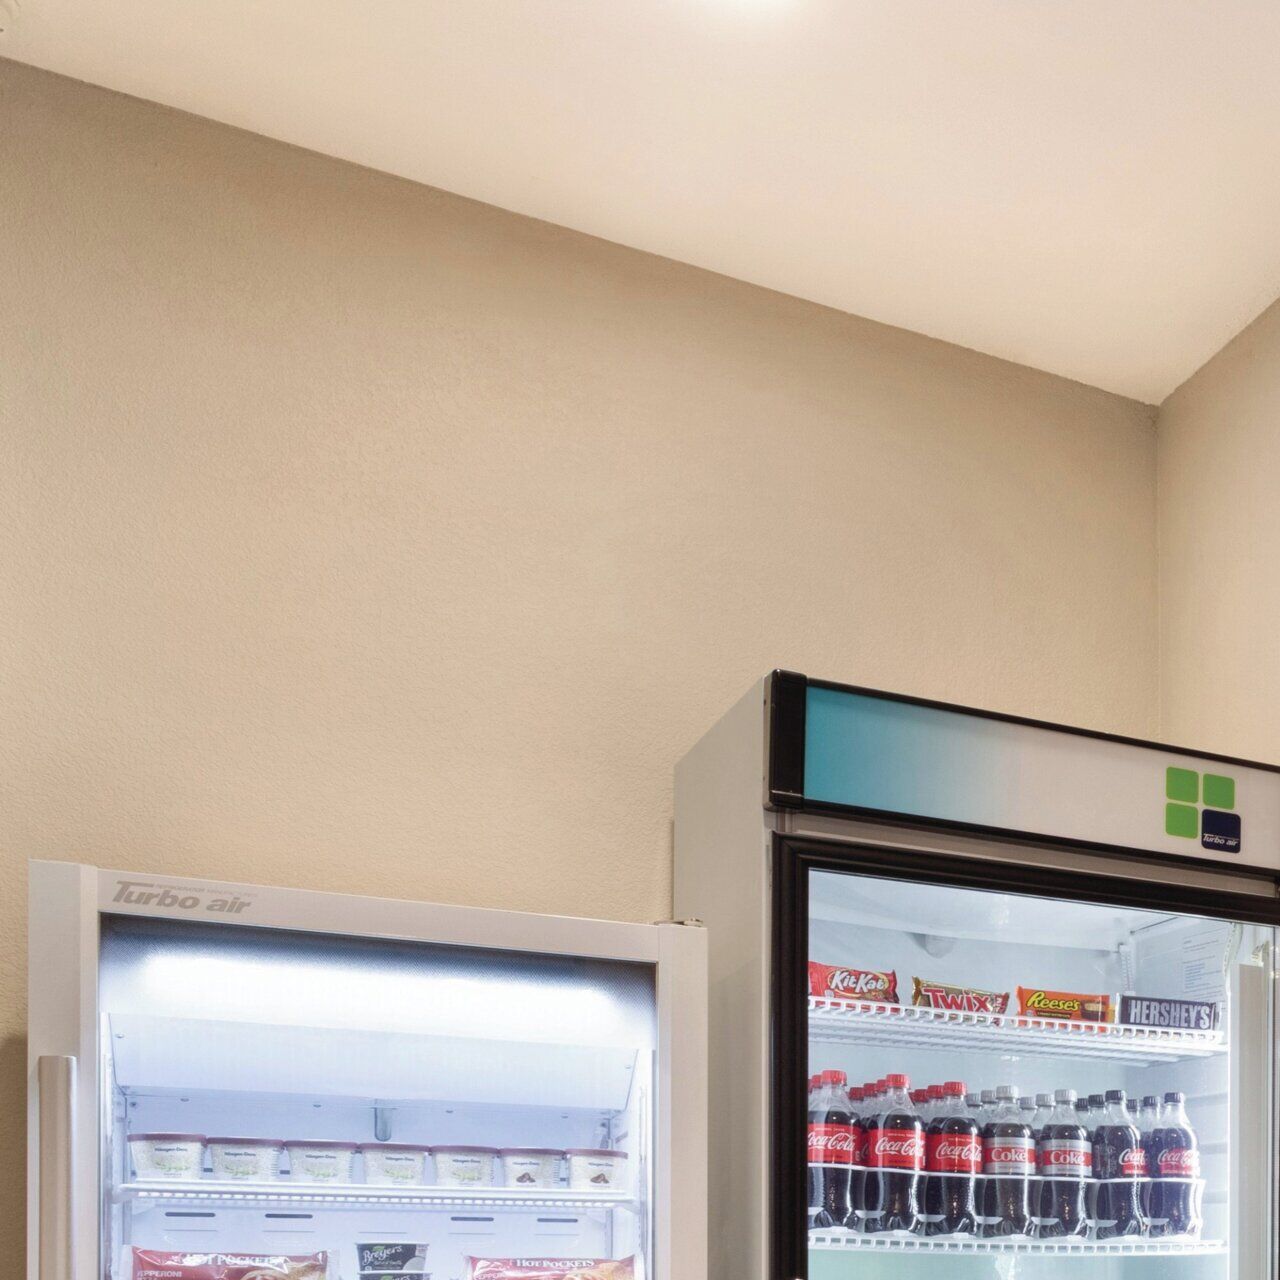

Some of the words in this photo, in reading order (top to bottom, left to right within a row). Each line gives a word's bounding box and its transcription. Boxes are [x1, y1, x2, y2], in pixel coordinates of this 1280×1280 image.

[1202, 832, 1226, 845] Turbo
[112, 880, 200, 910] Turbo
[205, 896, 252, 915] air
[1026, 990, 1080, 1013] Reese's
[1128, 999, 1211, 1031] HERSHEY'S
[990, 1146, 1028, 1163] Coke
[1049, 1148, 1086, 1165] Coke
[363, 1248, 404, 1264] Breyers
